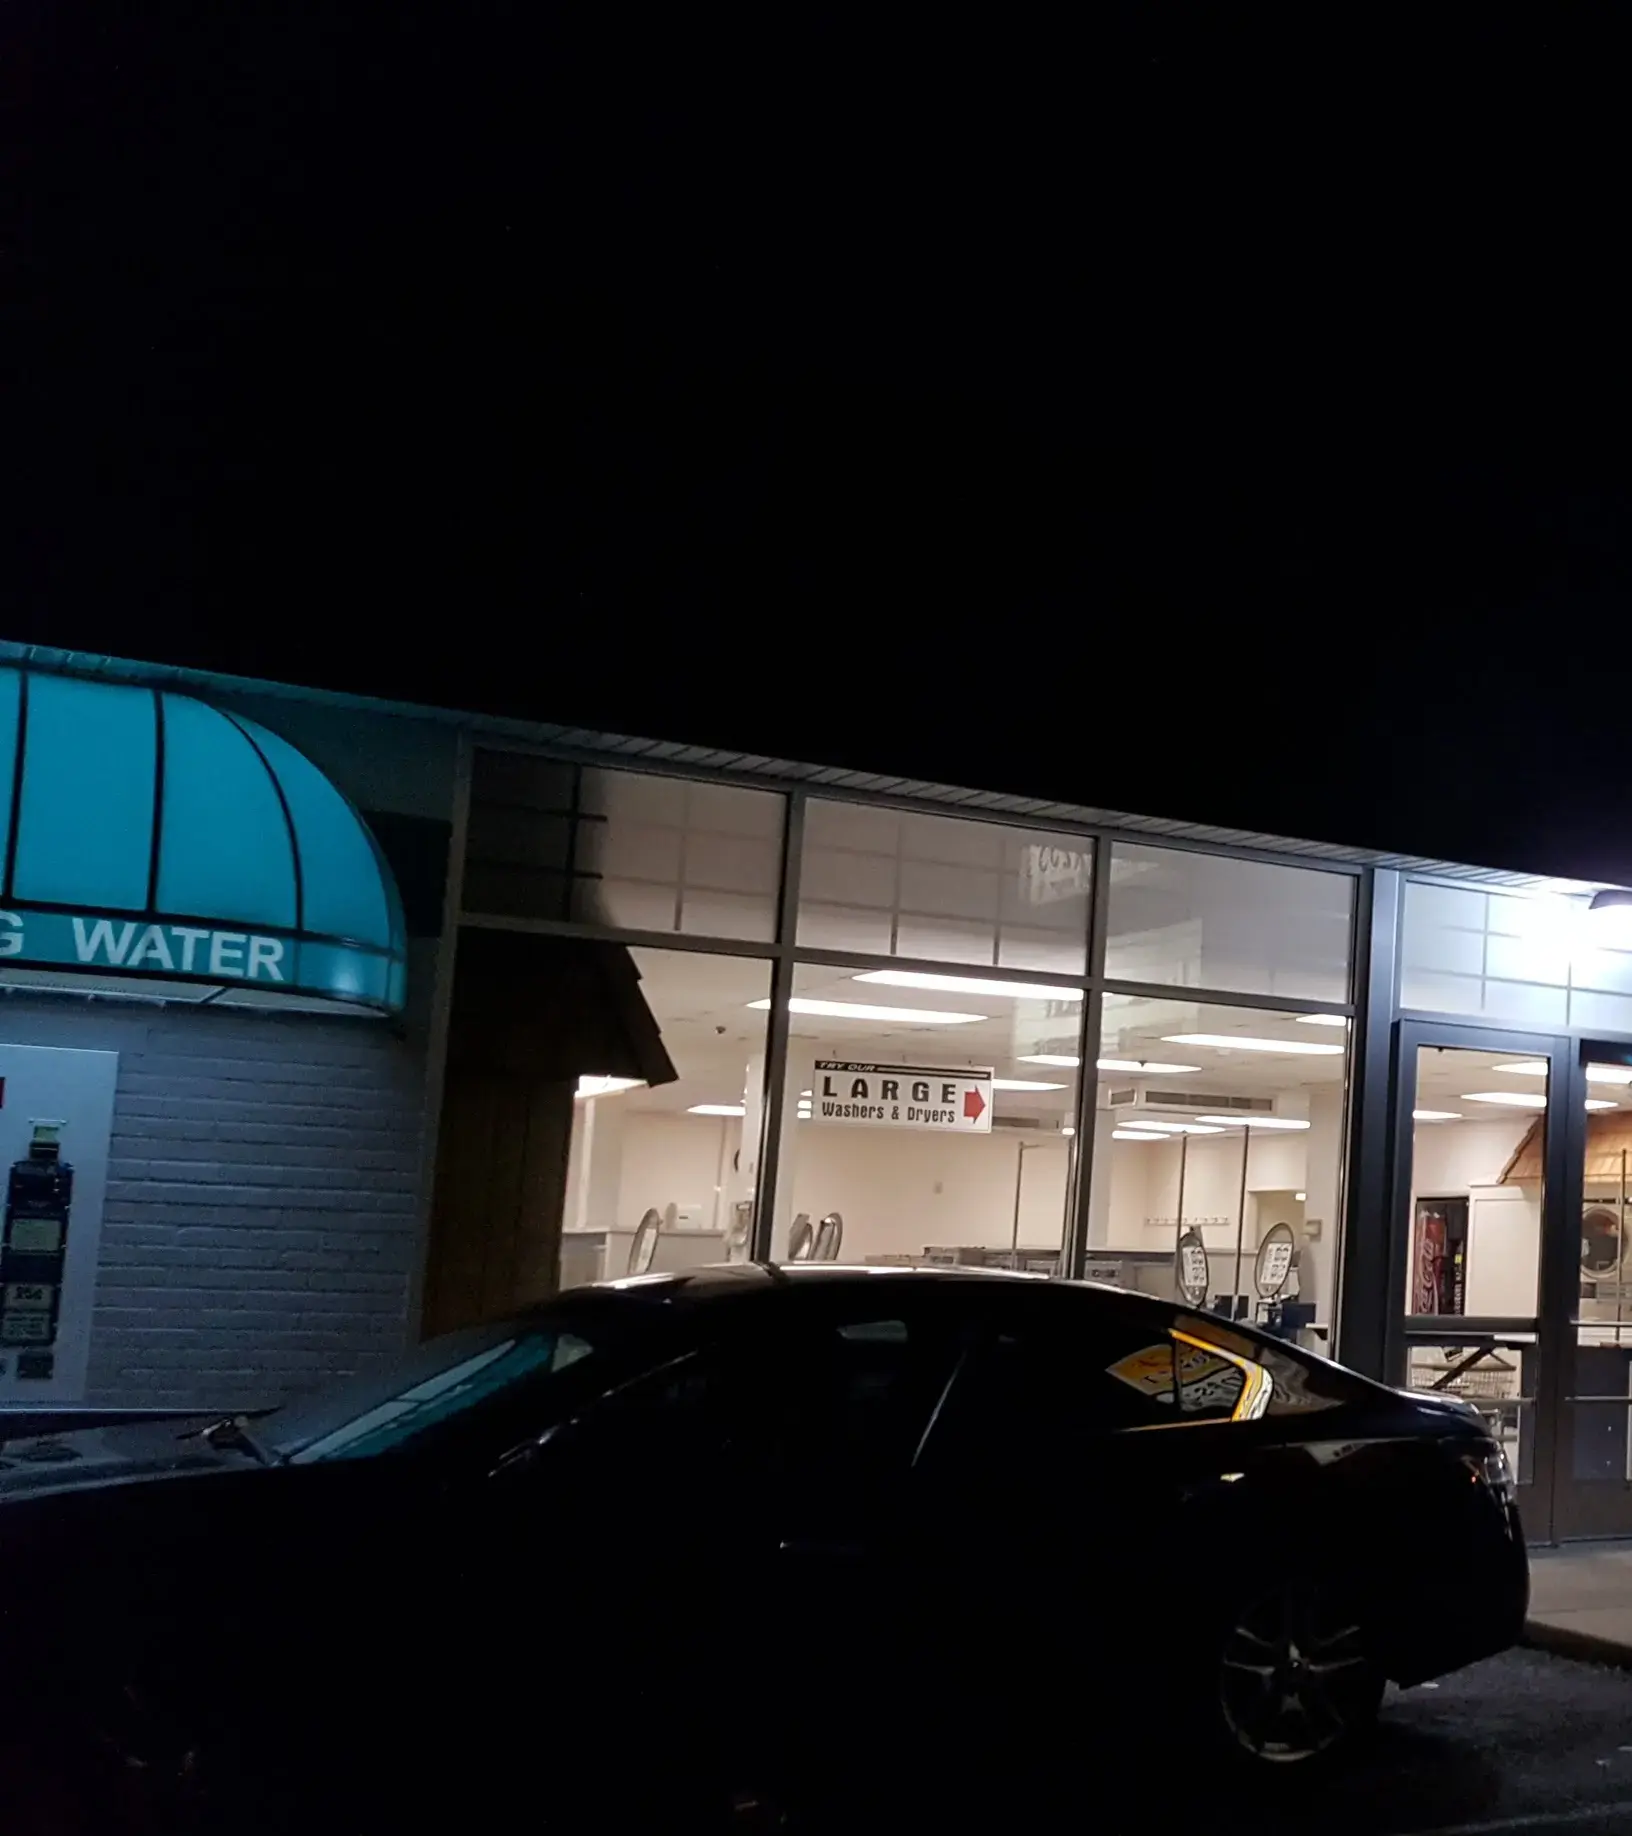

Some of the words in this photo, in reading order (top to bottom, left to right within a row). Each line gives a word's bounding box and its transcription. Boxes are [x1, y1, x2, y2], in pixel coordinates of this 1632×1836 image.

[71, 916, 285, 981] WATER
[819, 1061, 844, 1070] TRY
[848, 1064, 876, 1072] OUR
[822, 1076, 957, 1104] LARGE
[822, 1101, 885, 1121] Washers
[891, 1105, 900, 1121] &
[907, 1106, 956, 1124] Dryers
